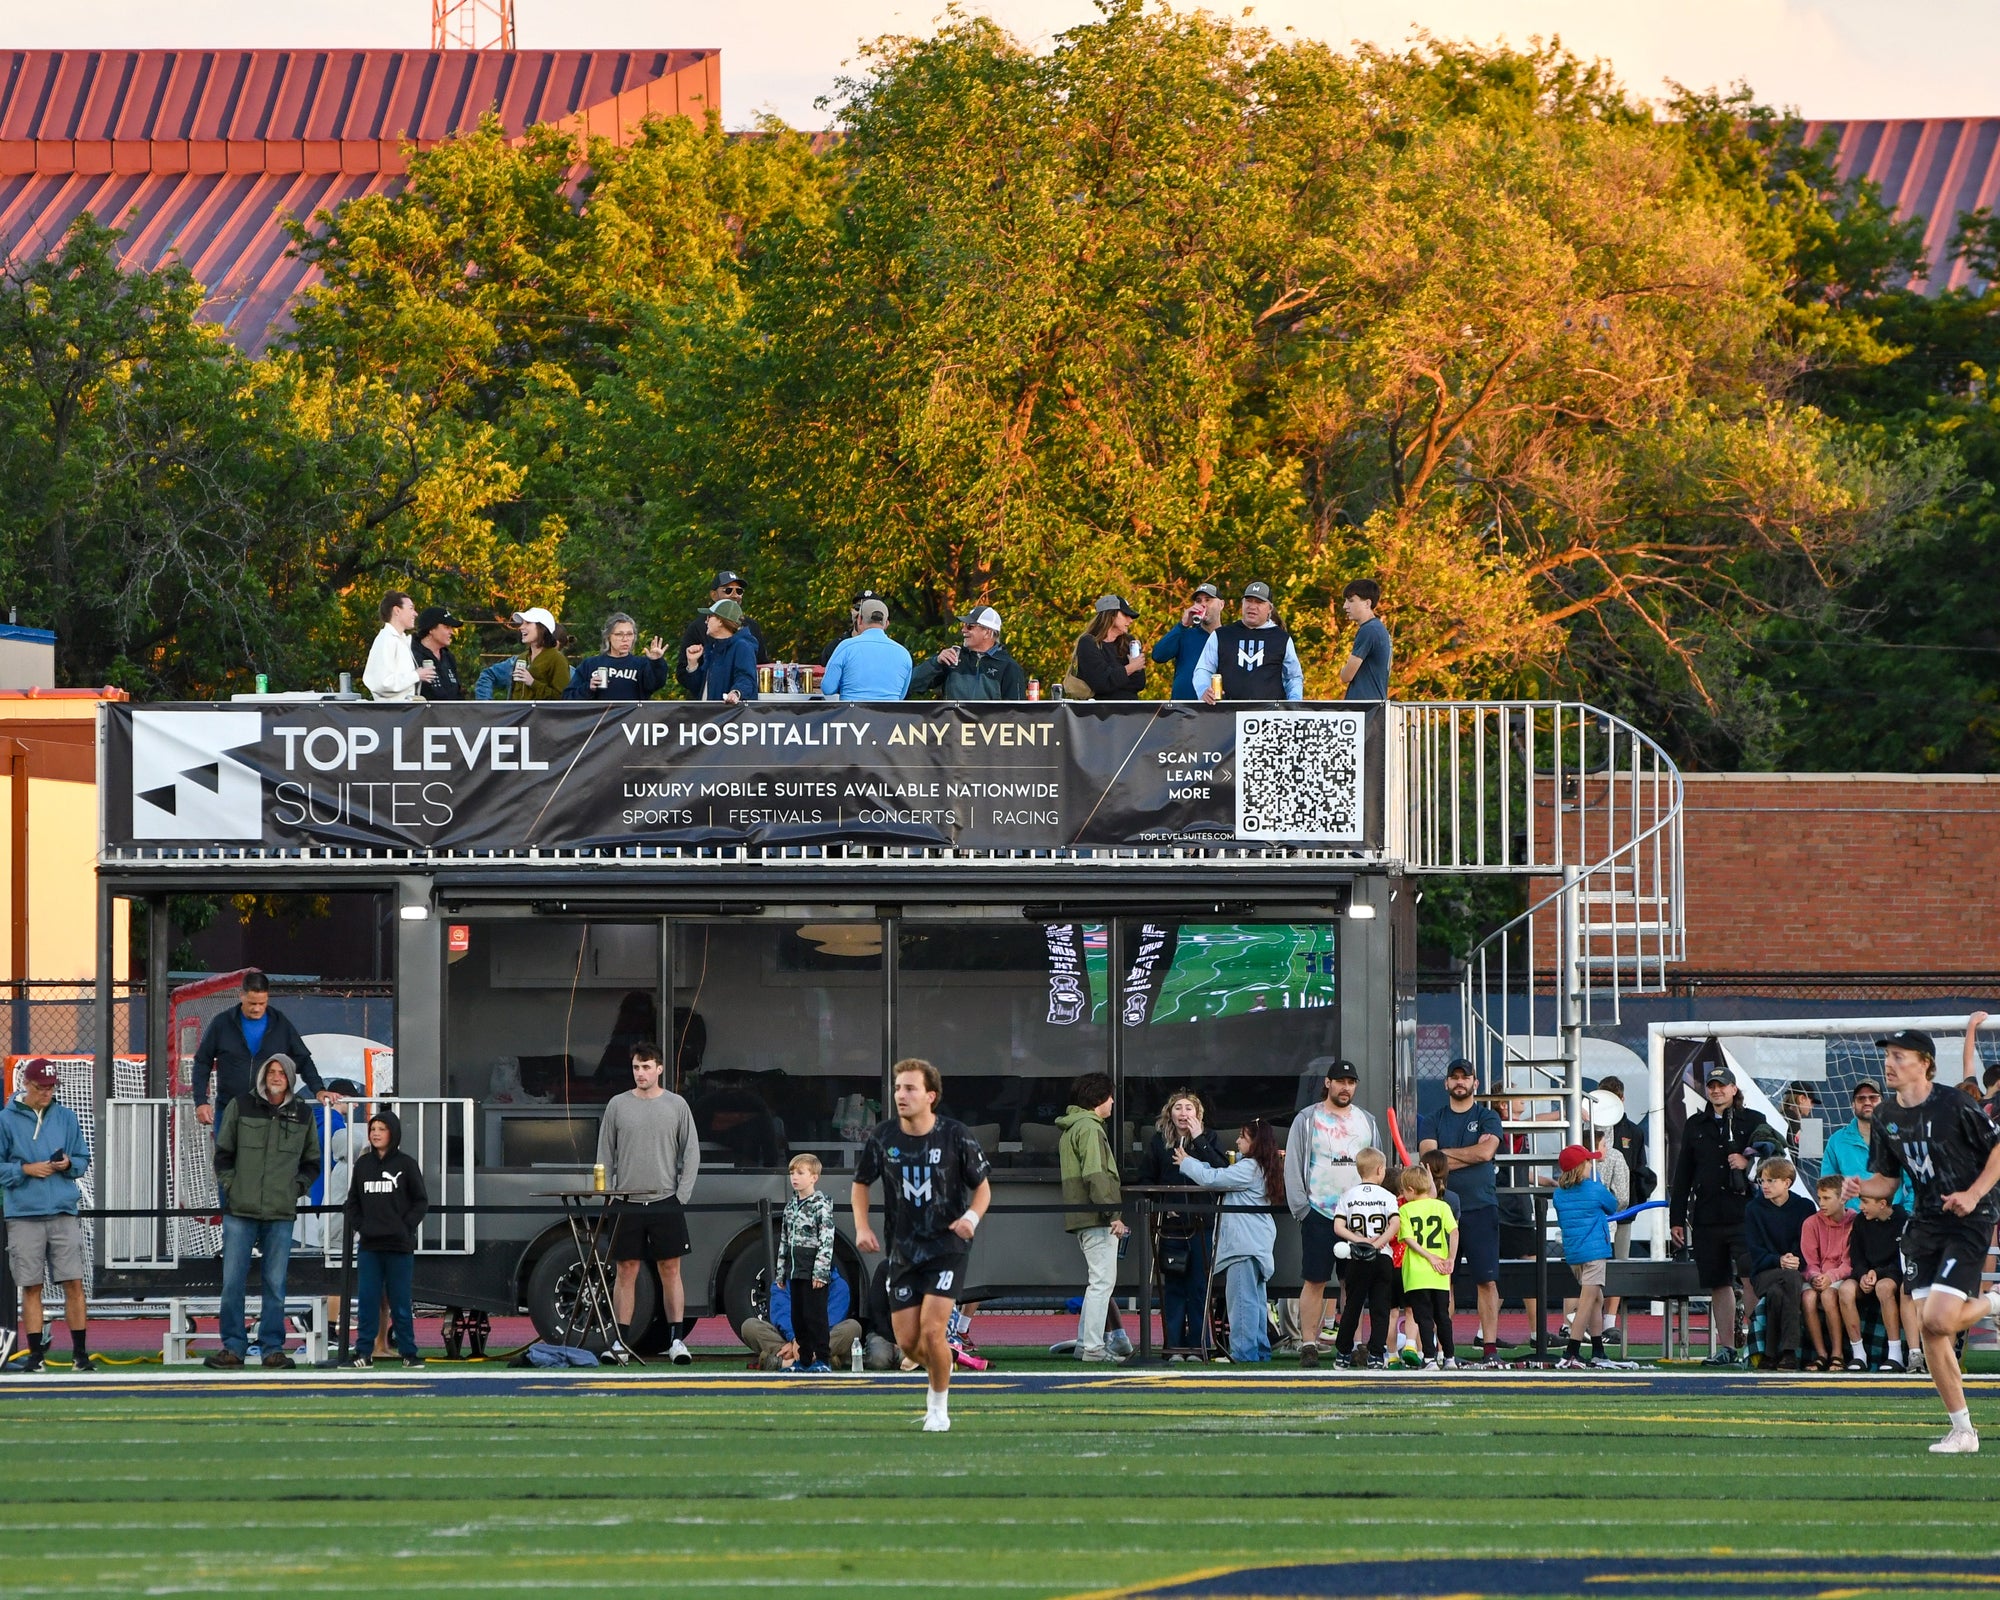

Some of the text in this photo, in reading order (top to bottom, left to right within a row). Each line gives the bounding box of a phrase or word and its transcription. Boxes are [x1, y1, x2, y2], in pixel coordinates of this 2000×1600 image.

[609, 667, 638, 682] PAUL
[622, 722, 1061, 746] VIP HOSPITALITY. ANY EVENT.
[273, 726, 549, 771] TOP LEVEL
[1158, 752, 1222, 764] SCAN TO
[1166, 770, 1213, 782] LEARN
[623, 783, 1059, 798] LUXURY MOBILE SUITES AVAILABLE NATIONWIDE
[1169, 788, 1211, 800] MORE
[275, 782, 454, 827] SUITES
[622, 810, 1059, 825] SPORTS FESTIVALS CONCERTS RACING
[1139, 832, 1235, 842] TOPLEVELSUITES.COM
[1926, 1120, 1932, 1138] 1
[928, 1148, 942, 1164] 18
[364, 1181, 393, 1194] PUMA
[1347, 1200, 1387, 1208] BLACKHAWKS
[1410, 1215, 1442, 1249] 32
[1941, 1257, 1957, 1279] 1
[935, 1270, 954, 1291] 18
